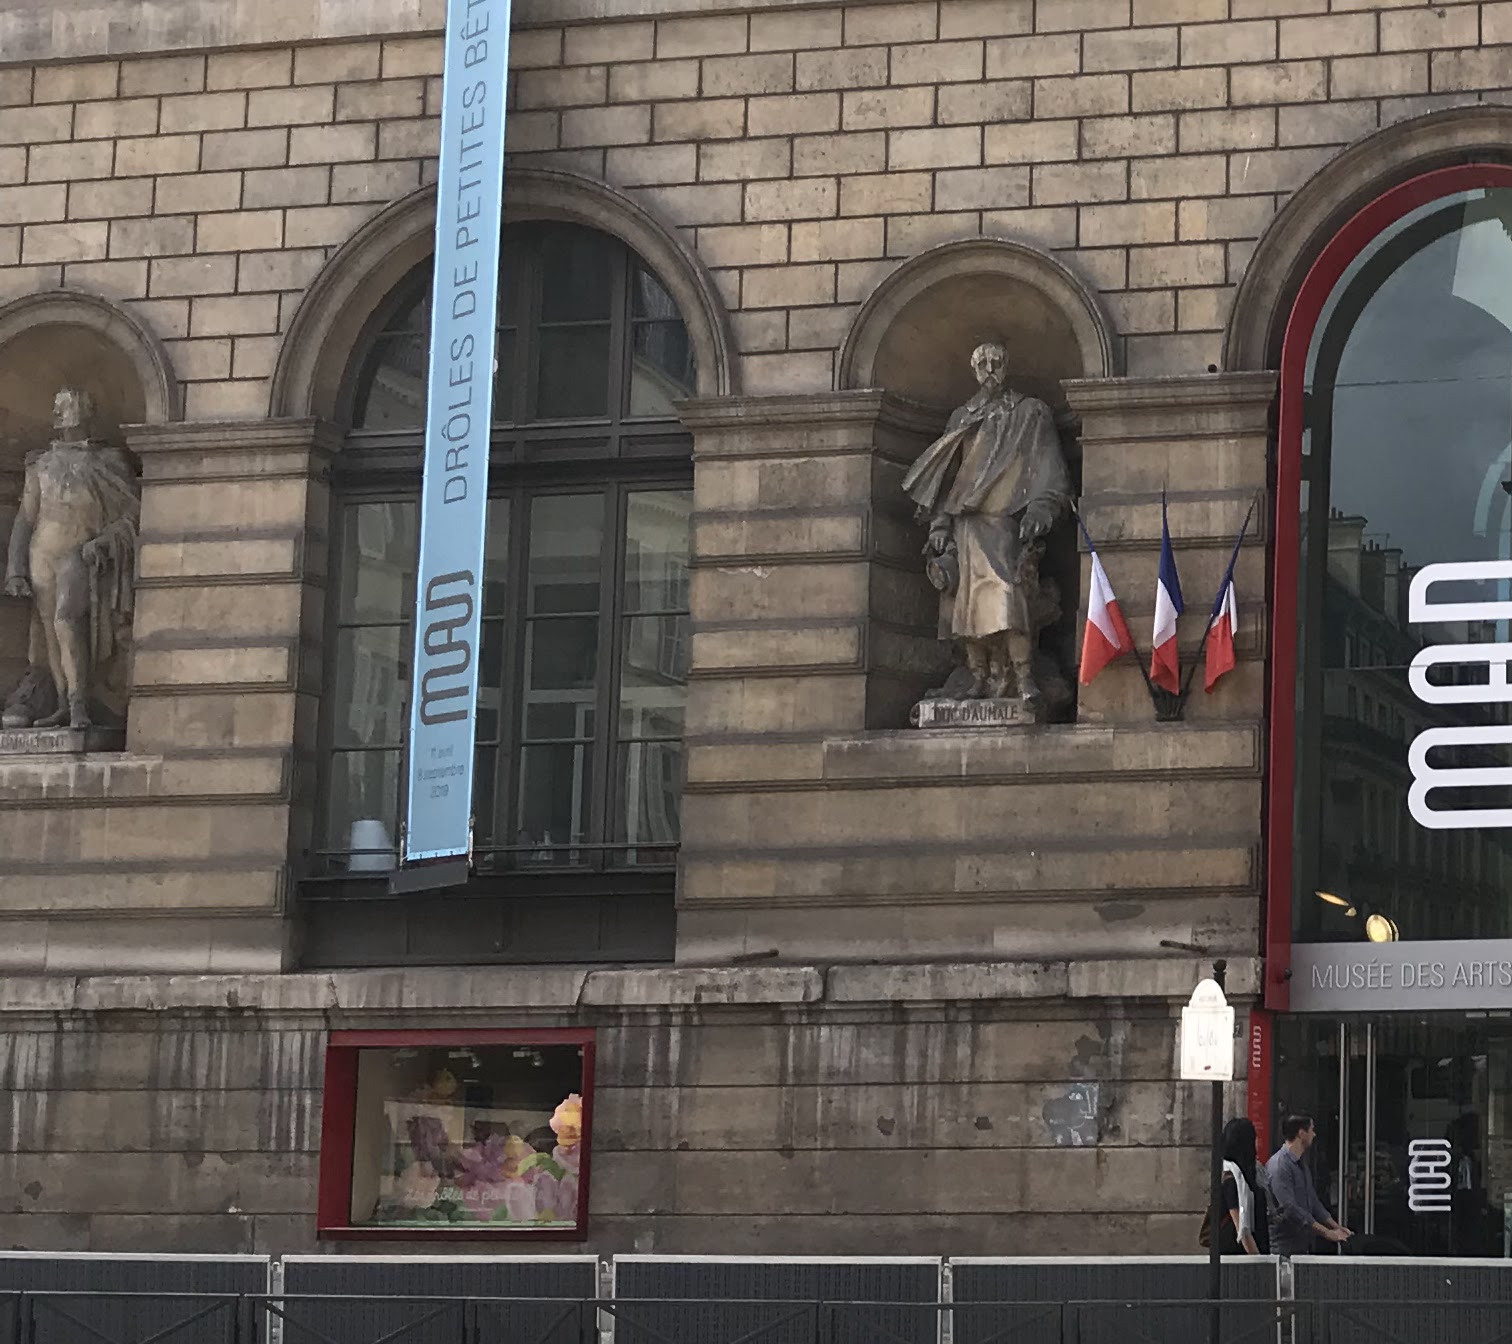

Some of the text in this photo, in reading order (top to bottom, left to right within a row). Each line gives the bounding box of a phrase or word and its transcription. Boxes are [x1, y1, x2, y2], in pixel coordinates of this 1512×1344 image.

[455, 79, 487, 251] PETITES
[453, 260, 479, 321] DE
[440, 333, 475, 505] DRÔLES
[420, 569, 475, 726] MAD
[1311, 957, 1393, 989] MUSÉE
[1400, 961, 1446, 988] DES
[1451, 960, 1512, 987] ARTS
[1408, 1138, 1452, 1212] MAD
